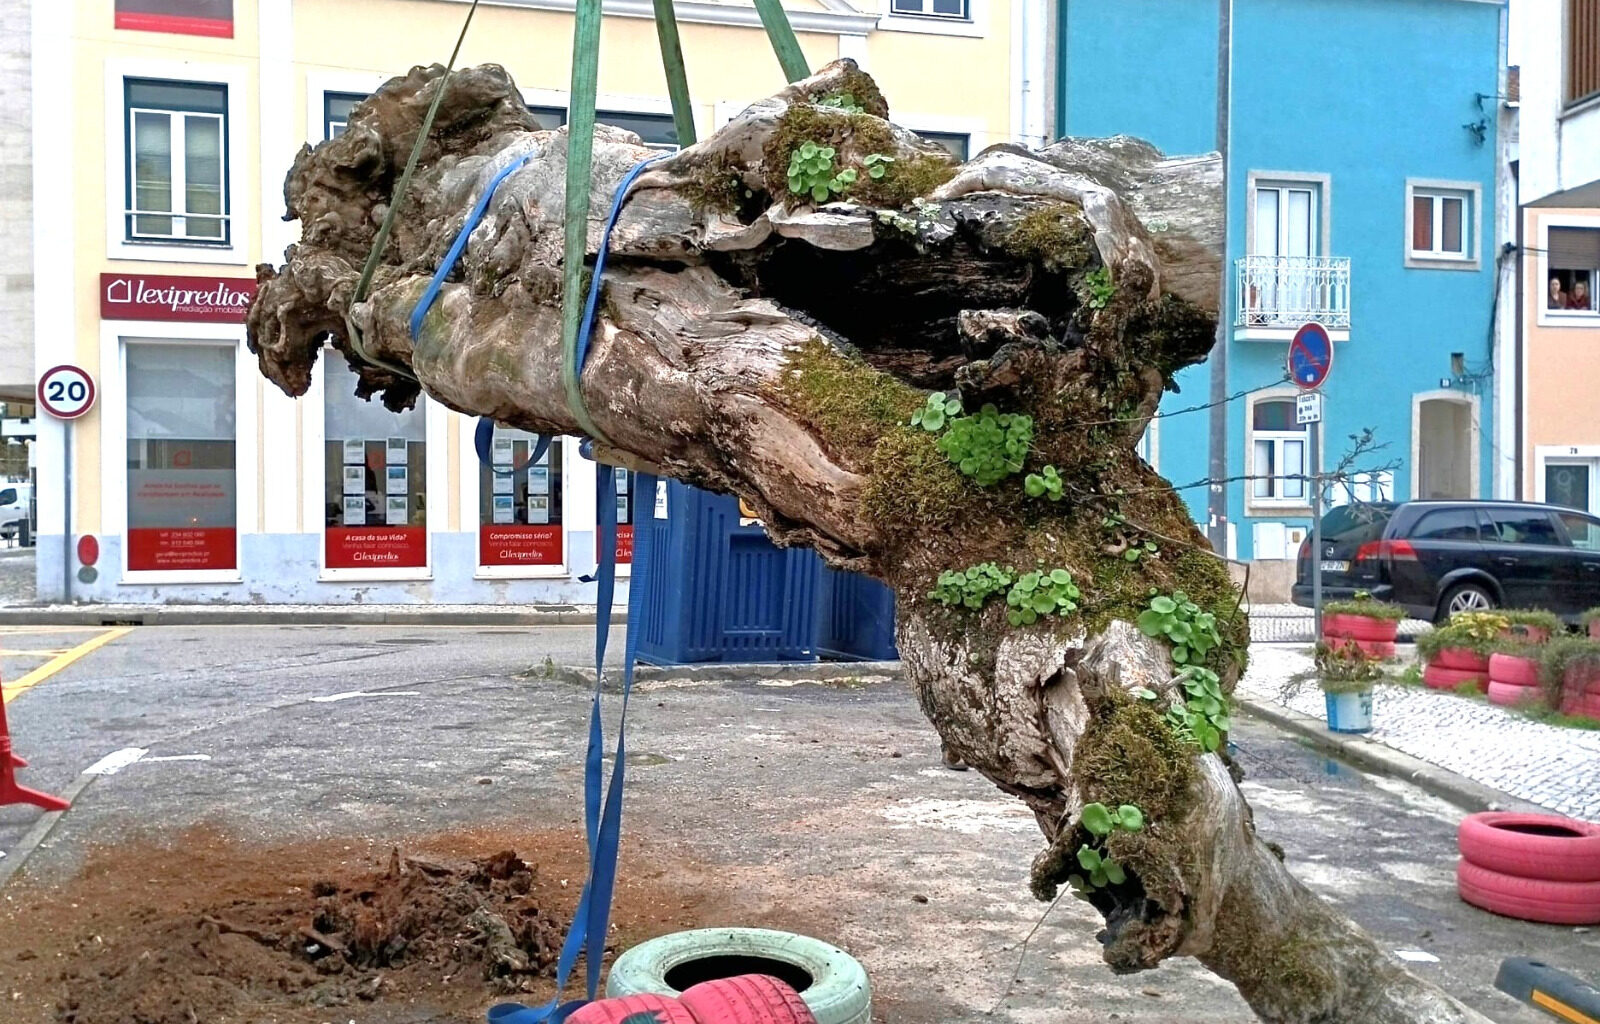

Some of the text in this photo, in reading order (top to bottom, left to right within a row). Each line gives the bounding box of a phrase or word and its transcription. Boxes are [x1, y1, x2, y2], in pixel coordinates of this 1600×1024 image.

[136, 280, 250, 311] lexipredios
[48, 381, 86, 402] 20
[490, 532, 533, 540] Compromisso
